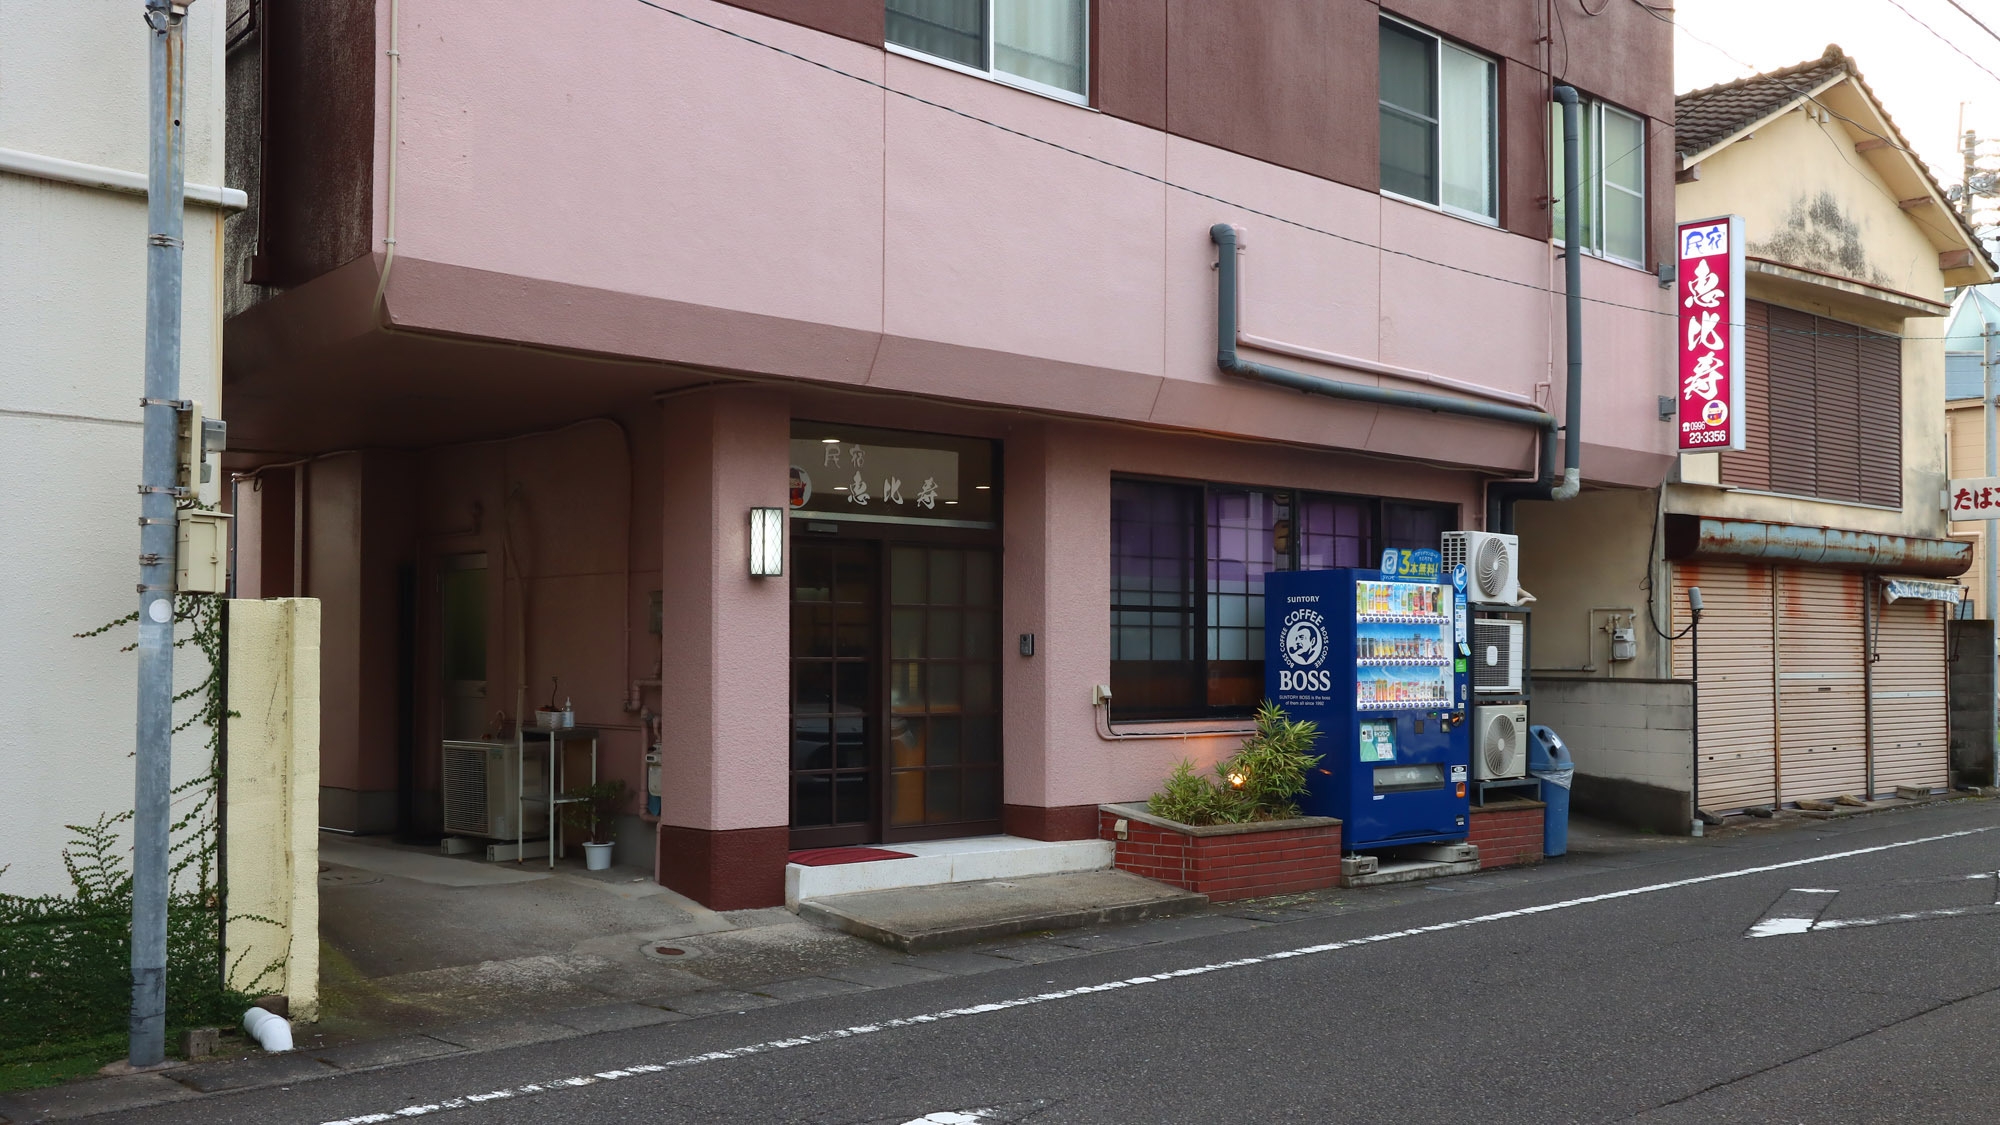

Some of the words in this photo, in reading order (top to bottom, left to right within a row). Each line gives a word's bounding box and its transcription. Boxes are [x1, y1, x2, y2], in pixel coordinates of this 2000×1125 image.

[1685, 226, 1725, 256] 民宿
[1684, 259, 1725, 401] 恵比寿
[1689, 430, 1726, 444] 23-3356
[1690, 421, 1706, 431] 0996
[823, 444, 866, 469] 民宿
[847, 470, 939, 510] 恵比寿
[1284, 609, 1324, 626] COFFEE
[1279, 670, 1331, 691] BOSS
